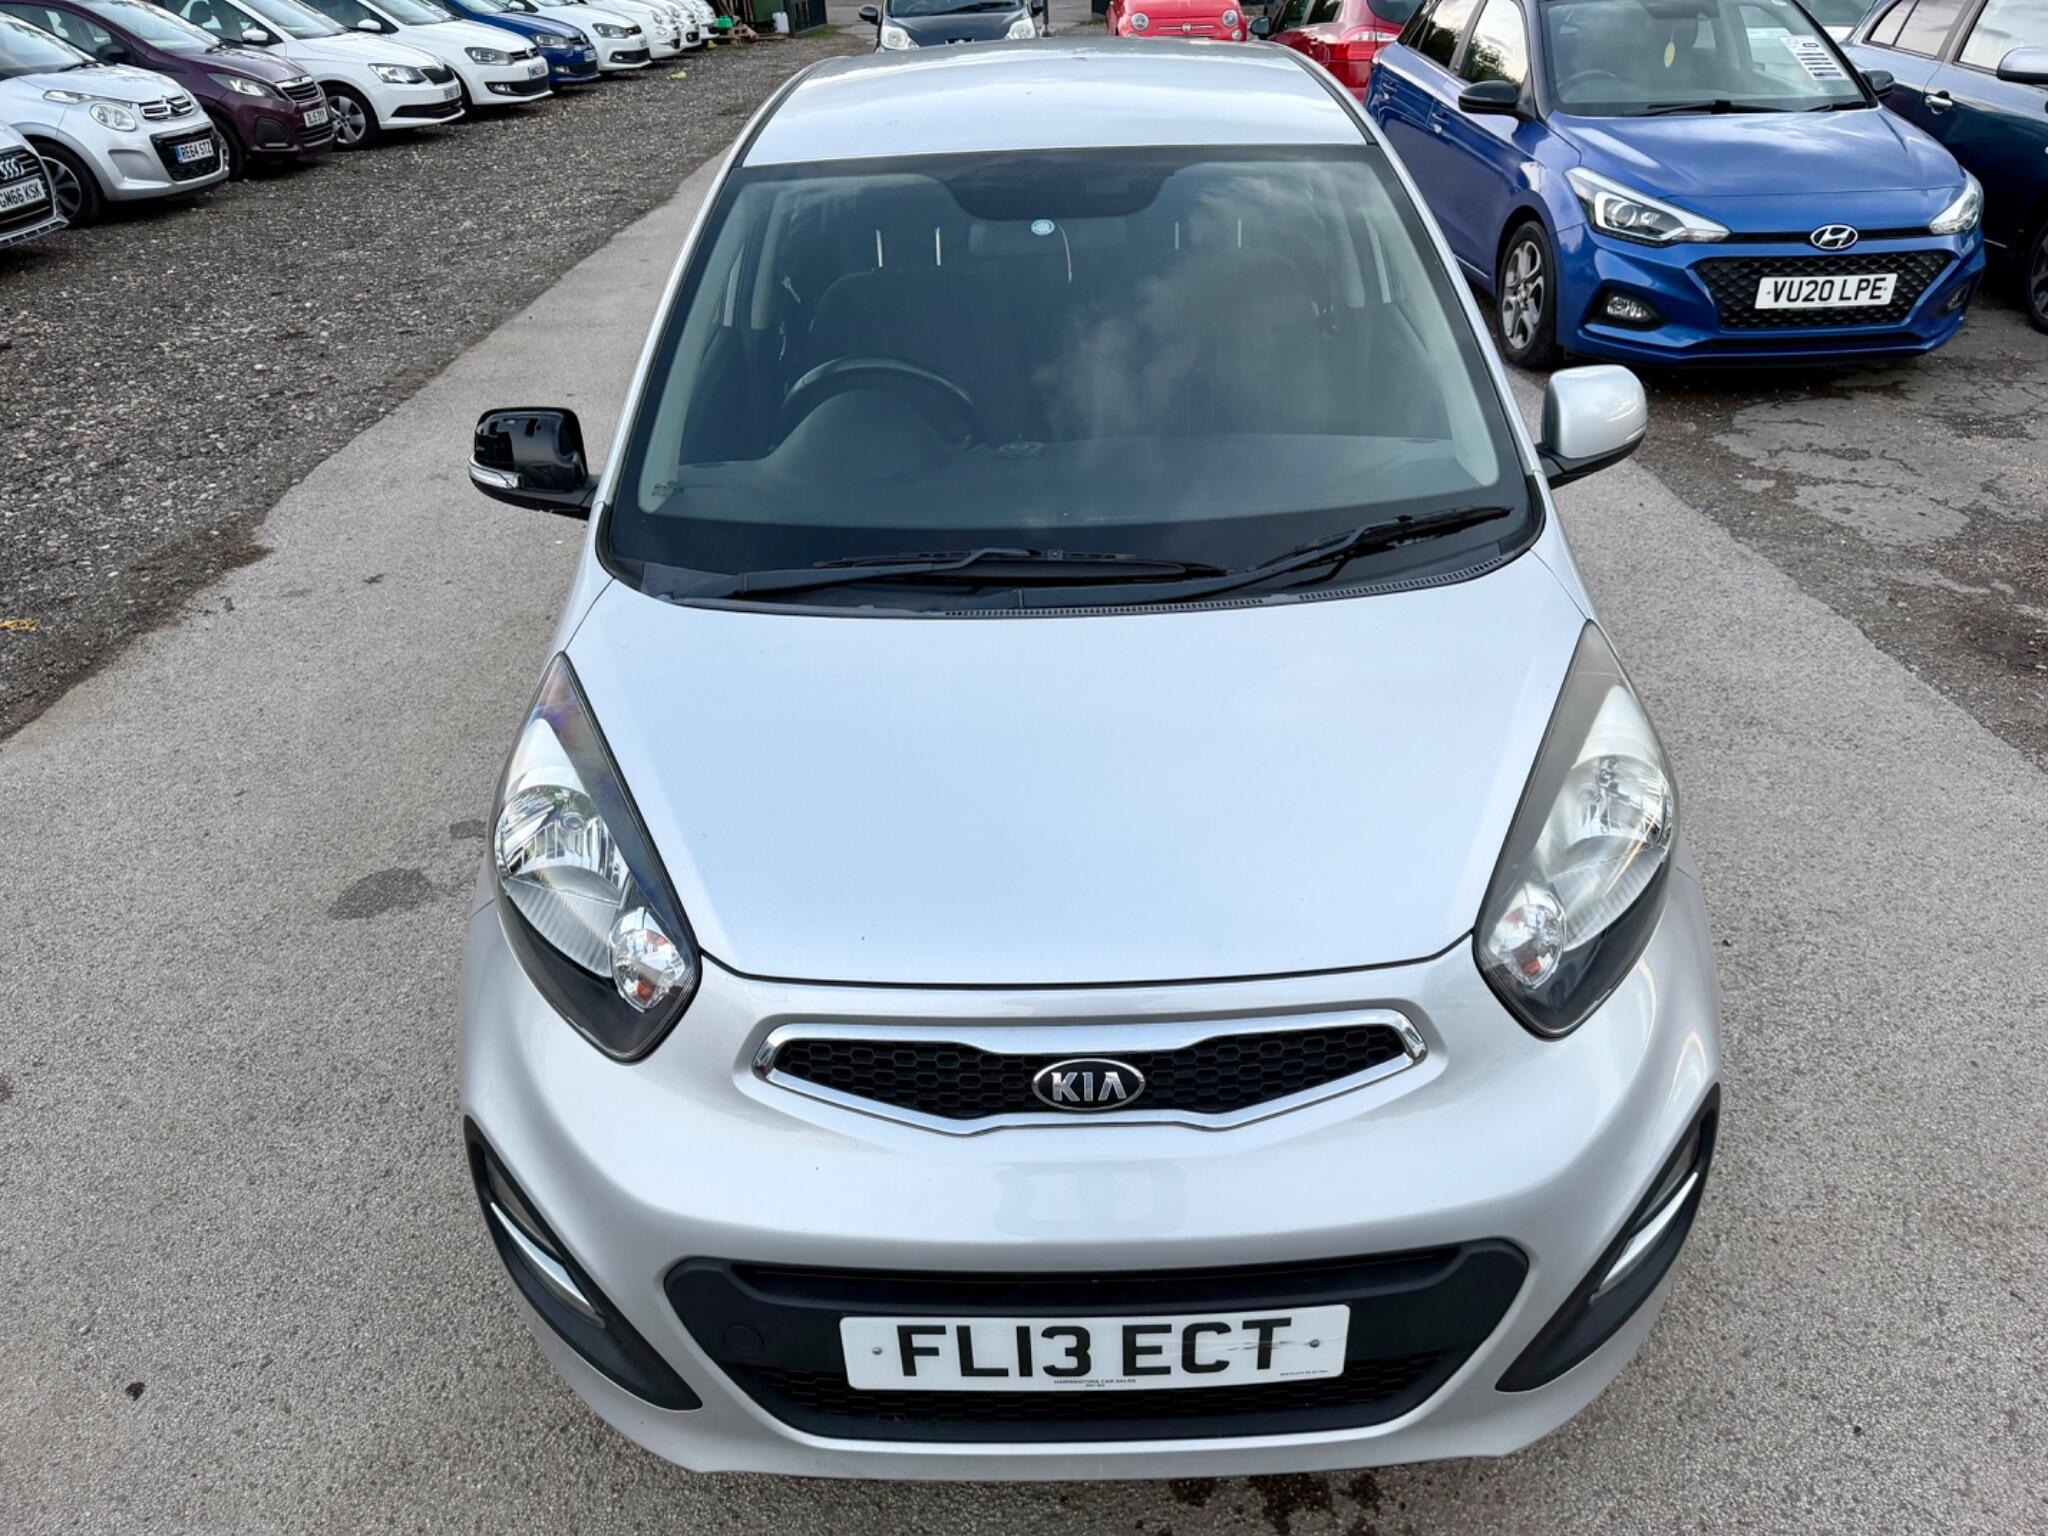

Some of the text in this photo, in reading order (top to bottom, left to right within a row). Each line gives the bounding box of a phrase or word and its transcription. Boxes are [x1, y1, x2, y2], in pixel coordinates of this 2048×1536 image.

[181, 144, 199, 160] RE64
[1773, 277, 1887, 303] VU20 LPE
[1050, 1071, 1127, 1102] KIA
[896, 1317, 1292, 1378] FL13 ECT
